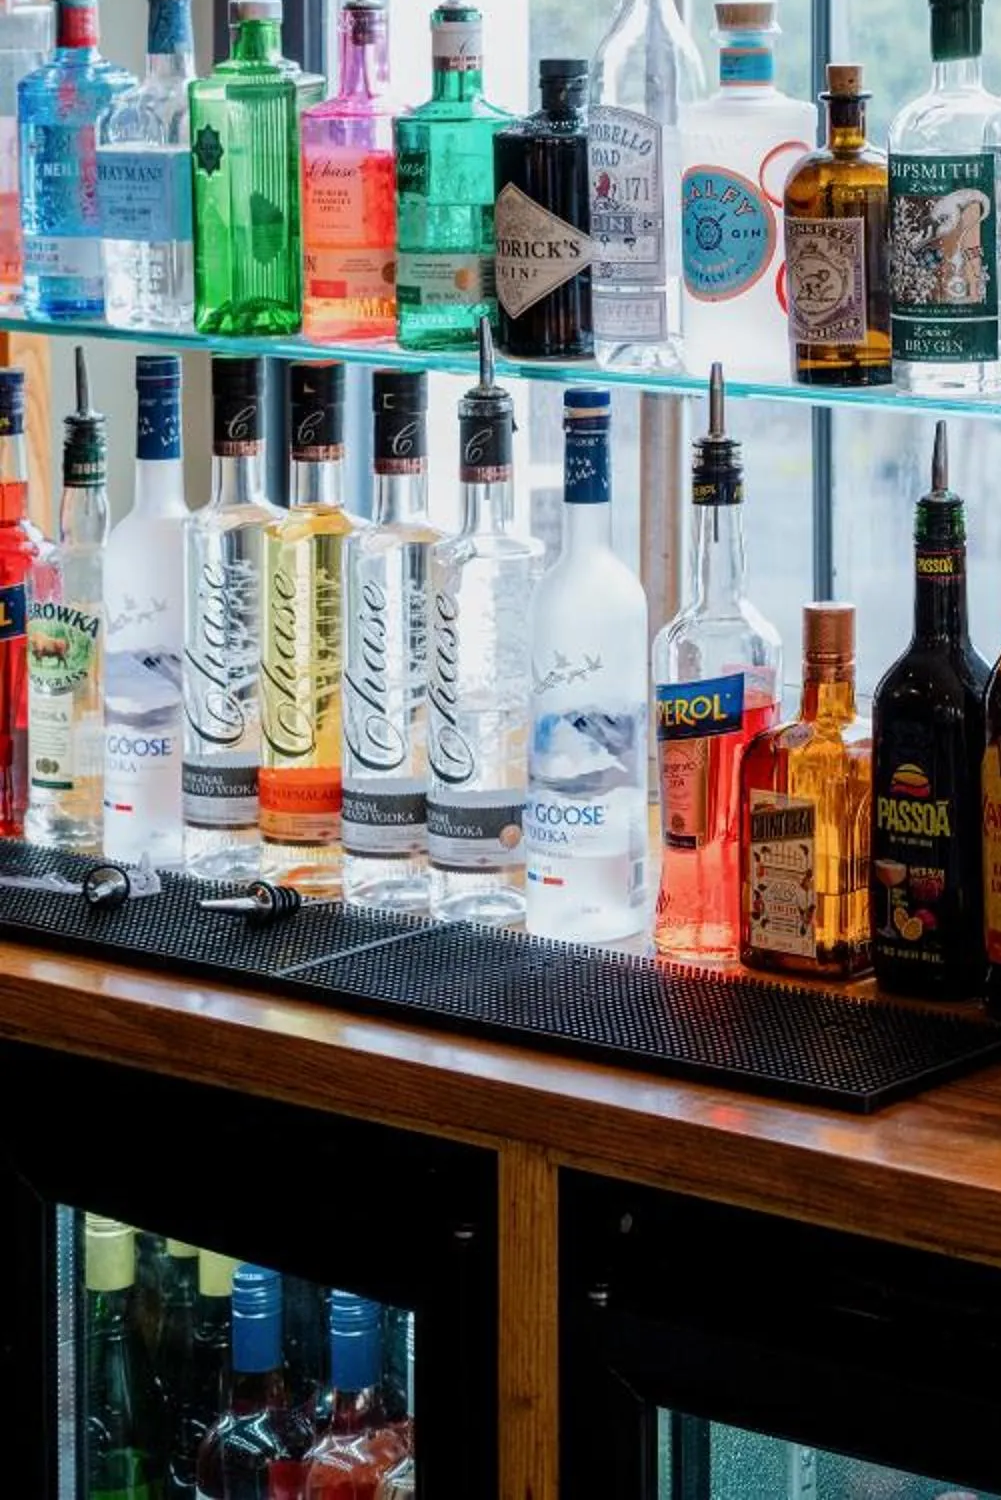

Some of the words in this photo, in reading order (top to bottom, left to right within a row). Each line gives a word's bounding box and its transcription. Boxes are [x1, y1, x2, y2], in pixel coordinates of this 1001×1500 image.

[590, 124, 652, 156] TOBELLO
[400, 163, 425, 177] ase
[891, 162, 980, 180] SIPSMITH
[690, 179, 757, 217] ALFY
[731, 229, 761, 239] GIN
[499, 238, 581, 260] DRICK'S
[905, 339, 930, 352] DRY
[932, 339, 964, 353] GIN
[184, 562, 245, 750] Chase
[262, 568, 318, 759] Chase
[342, 582, 409, 773] Chase
[426, 593, 475, 787] Chase
[659, 694, 728, 727] PEROL
[107, 735, 173, 757] GOOSE
[109, 757, 137, 773] DKA
[217, 783, 260, 797] VODKA
[370, 810, 416, 824] VODKA
[535, 803, 606, 826] GOOSE
[443, 822, 484, 837] VODKA
